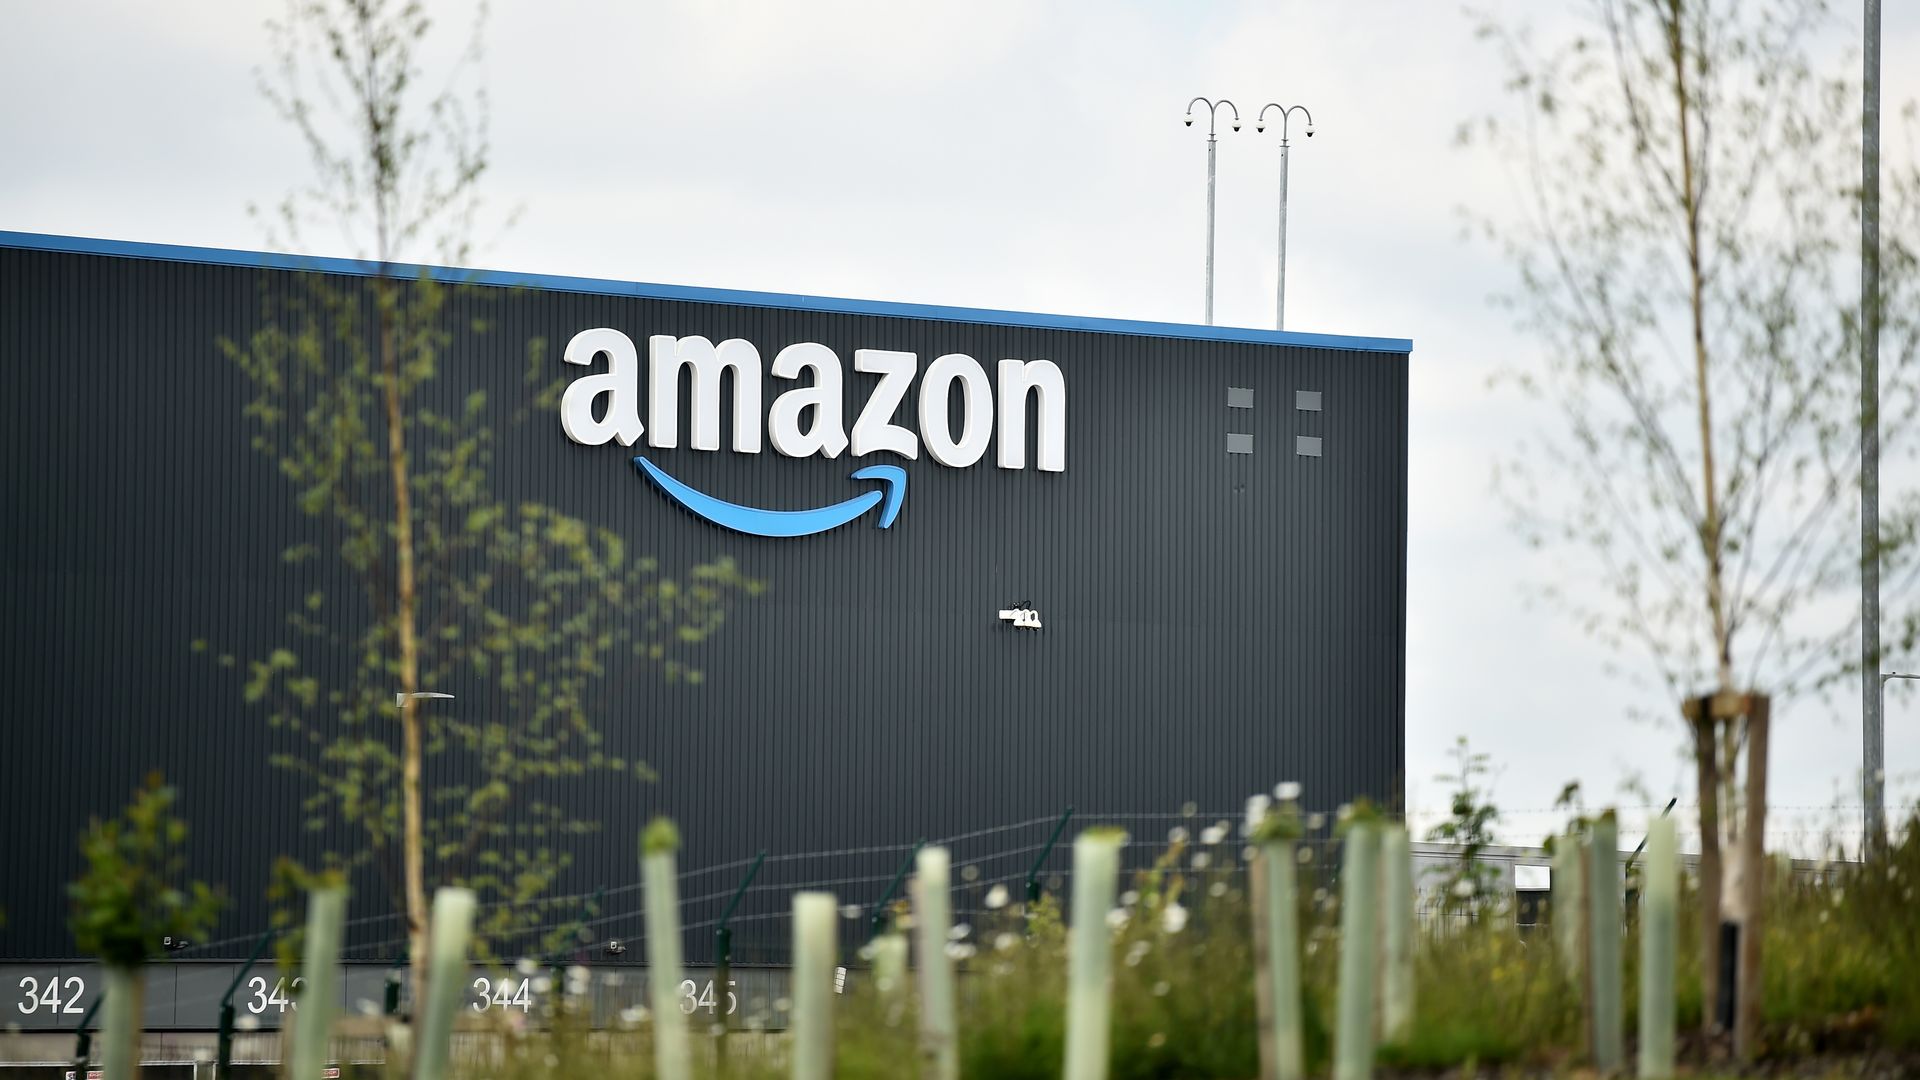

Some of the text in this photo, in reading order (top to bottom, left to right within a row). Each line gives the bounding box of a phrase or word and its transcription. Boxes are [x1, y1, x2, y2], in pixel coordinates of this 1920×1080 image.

[560, 327, 1066, 472] amazon
[17, 976, 85, 1015] 342
[472, 977, 532, 1014] 344
